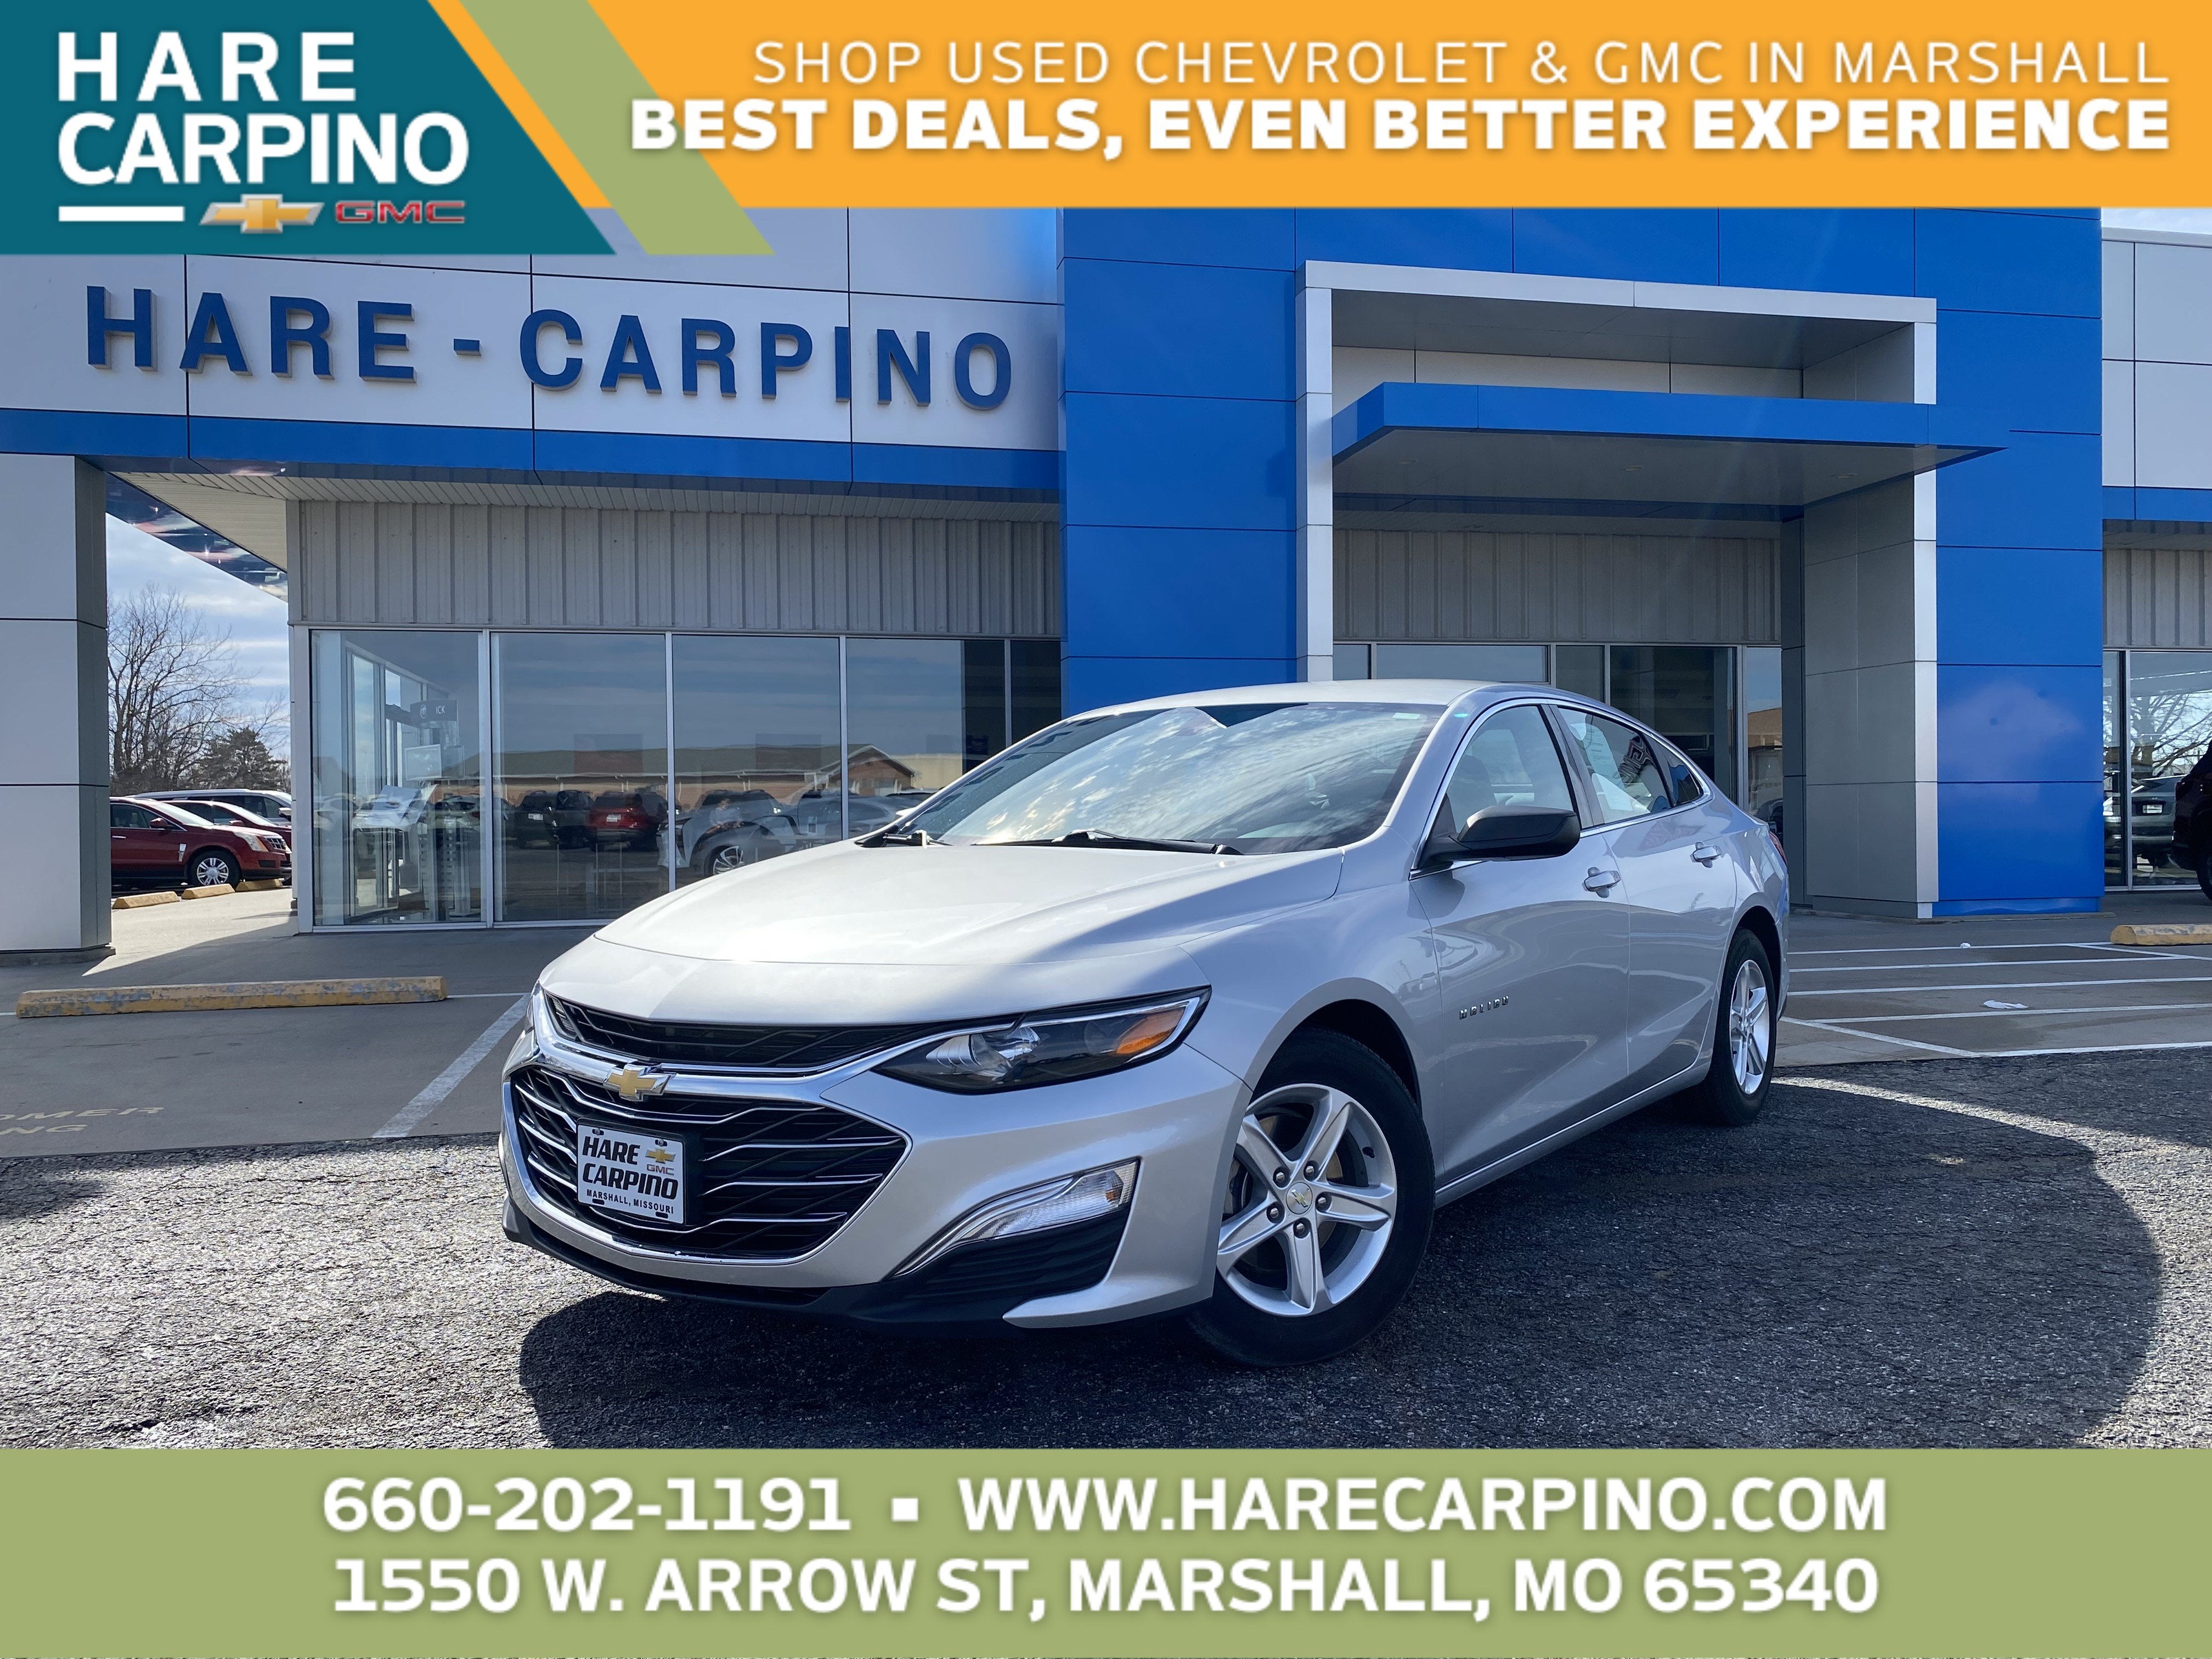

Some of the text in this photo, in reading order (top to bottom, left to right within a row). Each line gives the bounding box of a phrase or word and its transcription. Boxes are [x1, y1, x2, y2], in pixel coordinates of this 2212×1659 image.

[87, 285, 416, 383] HARE
[520, 309, 1012, 410] CARPINO
[582, 1136, 641, 1165] HARE
[582, 1163, 679, 1200] CARPINO
[646, 1164, 674, 1176] GMC
[586, 1189, 674, 1214] MARSHALL, MISSOURI
